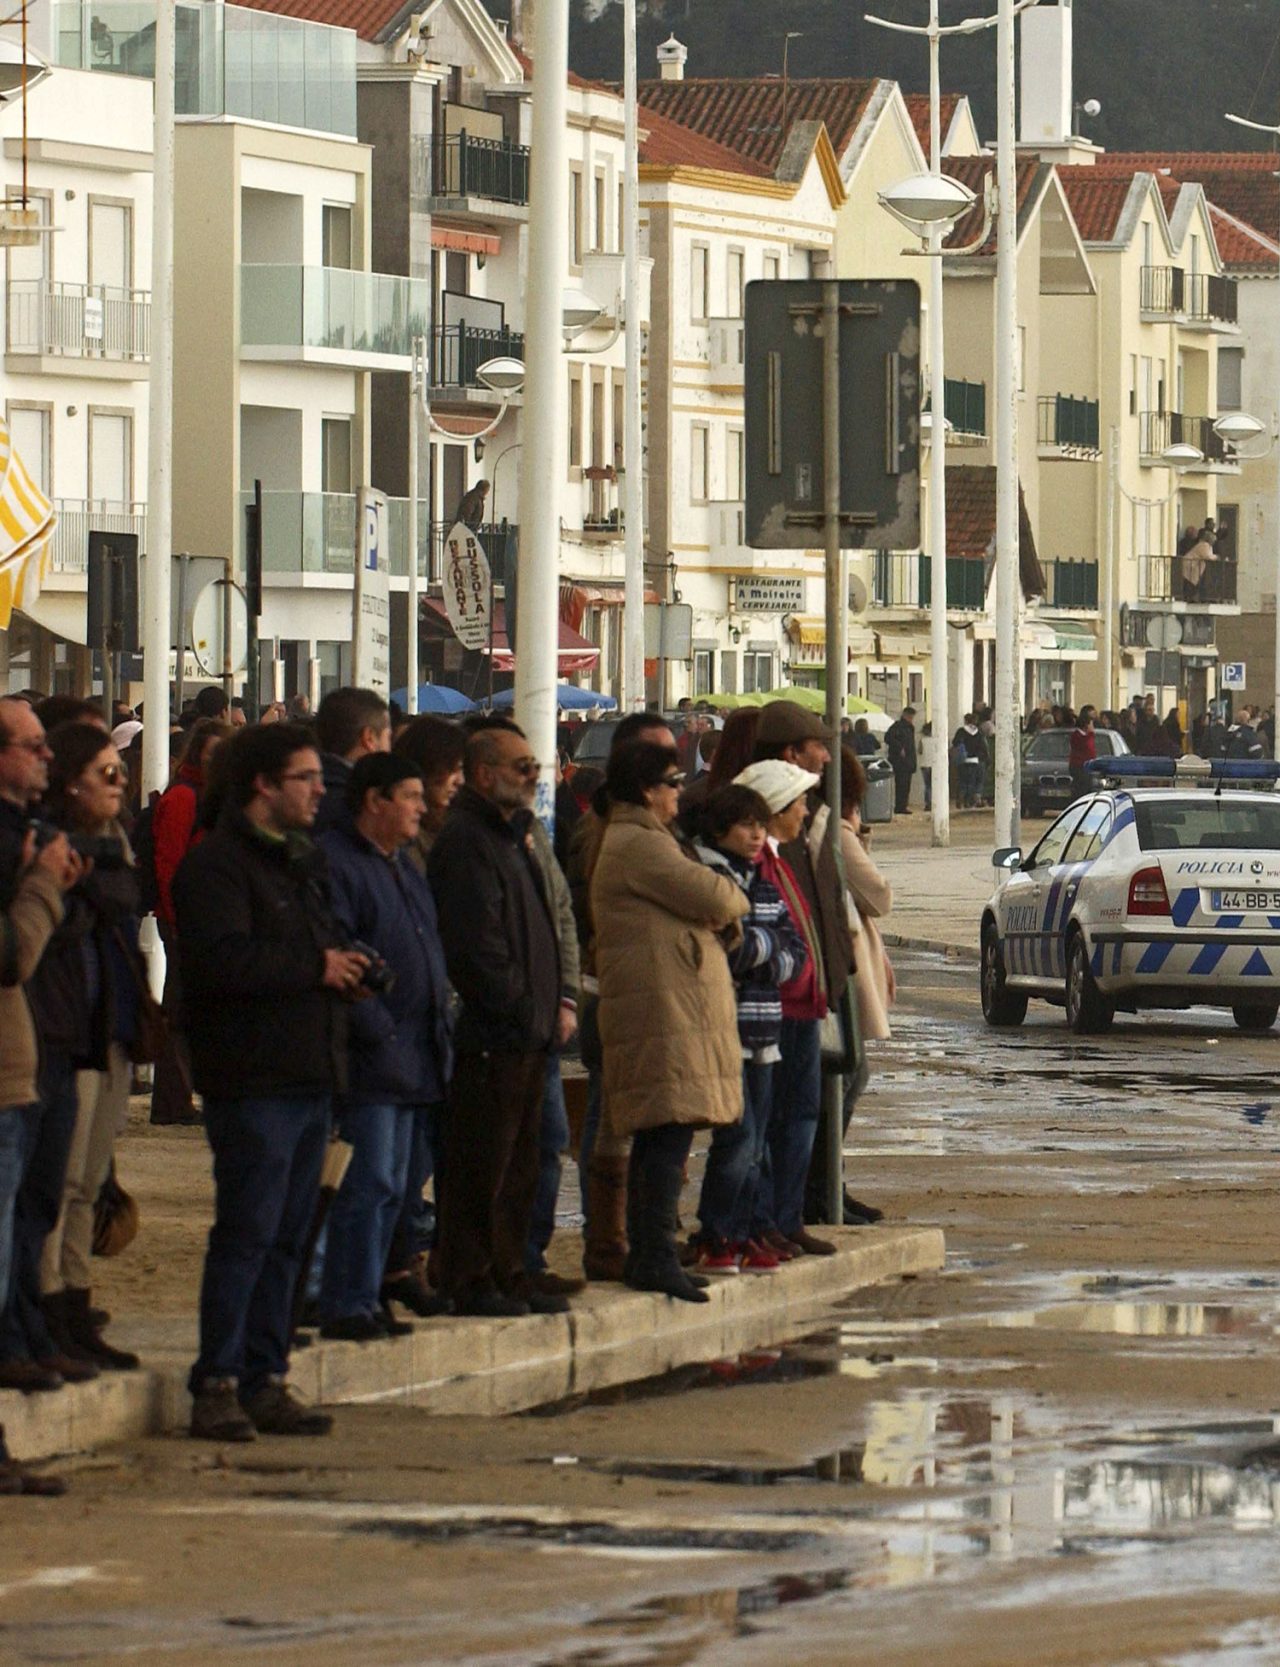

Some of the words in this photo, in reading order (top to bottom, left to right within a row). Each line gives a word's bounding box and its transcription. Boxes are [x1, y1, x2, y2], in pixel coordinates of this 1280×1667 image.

[466, 537, 484, 613] BUSSOLA
[738, 579, 802, 587] RESTAURANTE
[738, 589, 745, 598] A
[742, 601, 797, 609] CERVEJARIA
[1226, 665, 1236, 680] P
[1177, 862, 1244, 874] POLICIA
